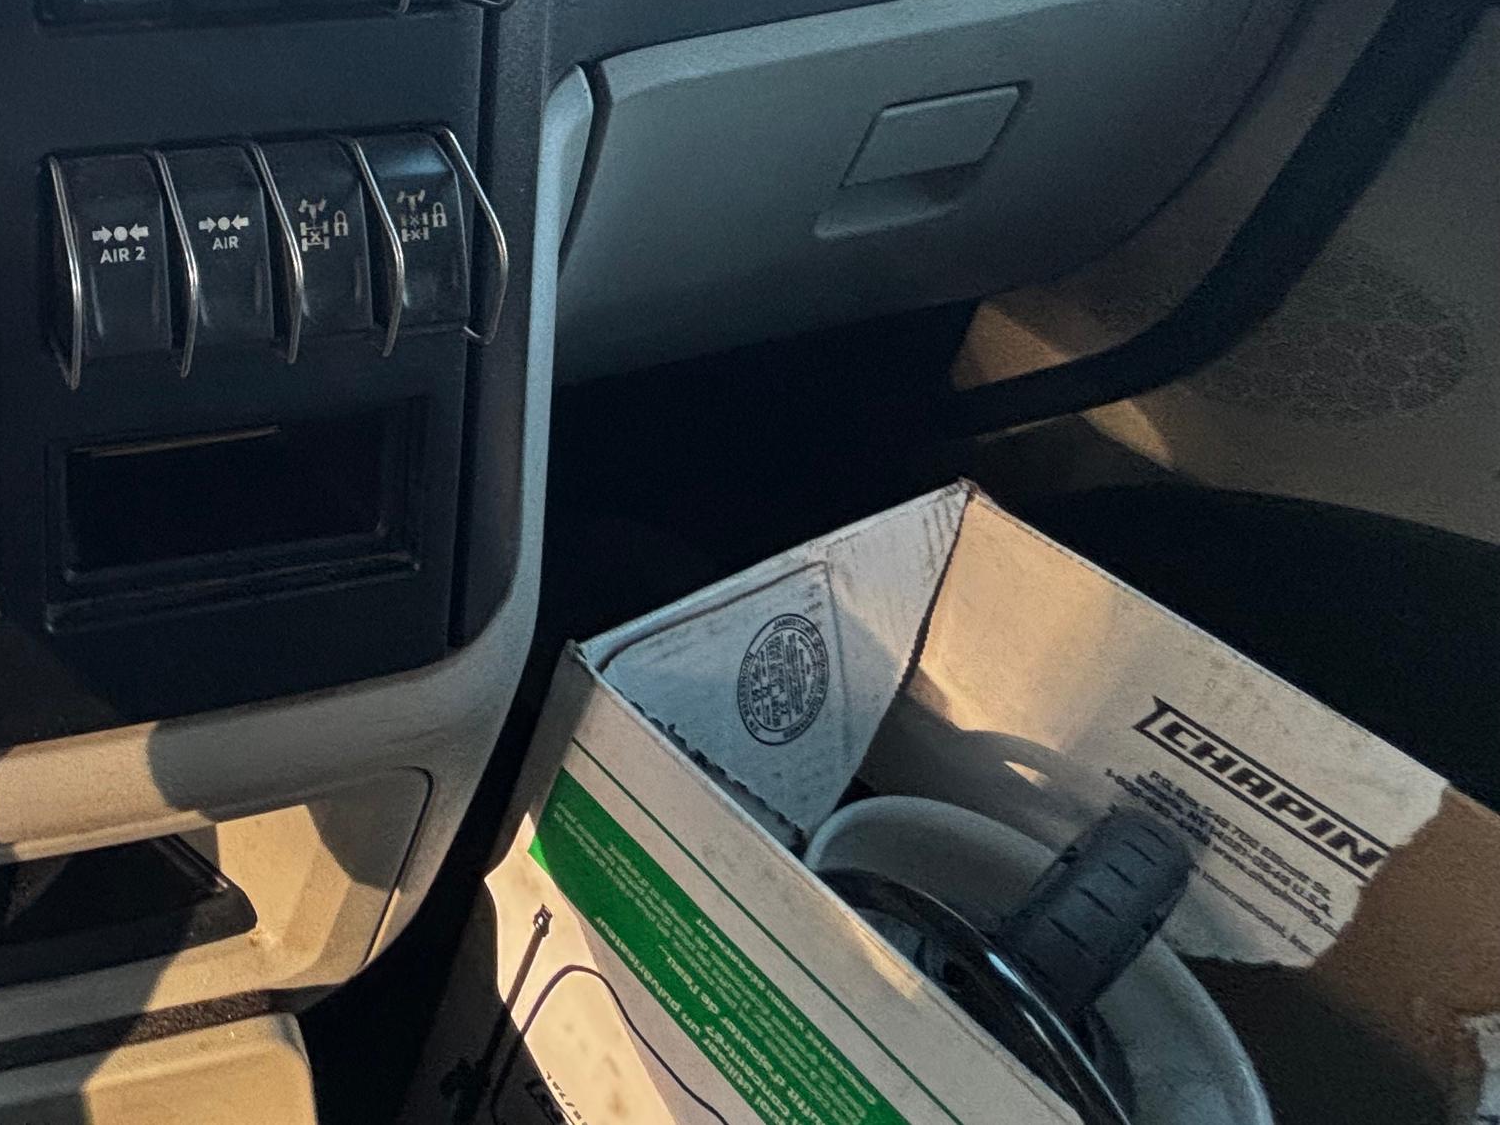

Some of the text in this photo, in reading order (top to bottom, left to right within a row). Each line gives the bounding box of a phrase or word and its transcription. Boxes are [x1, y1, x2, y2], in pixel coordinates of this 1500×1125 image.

[100, 246, 147, 264] AIR 2
[212, 235, 240, 251] AIR
[1158, 720, 1386, 870] CHAPIN
[700, 991, 720, 1015] de
[680, 1012, 701, 1036] un
